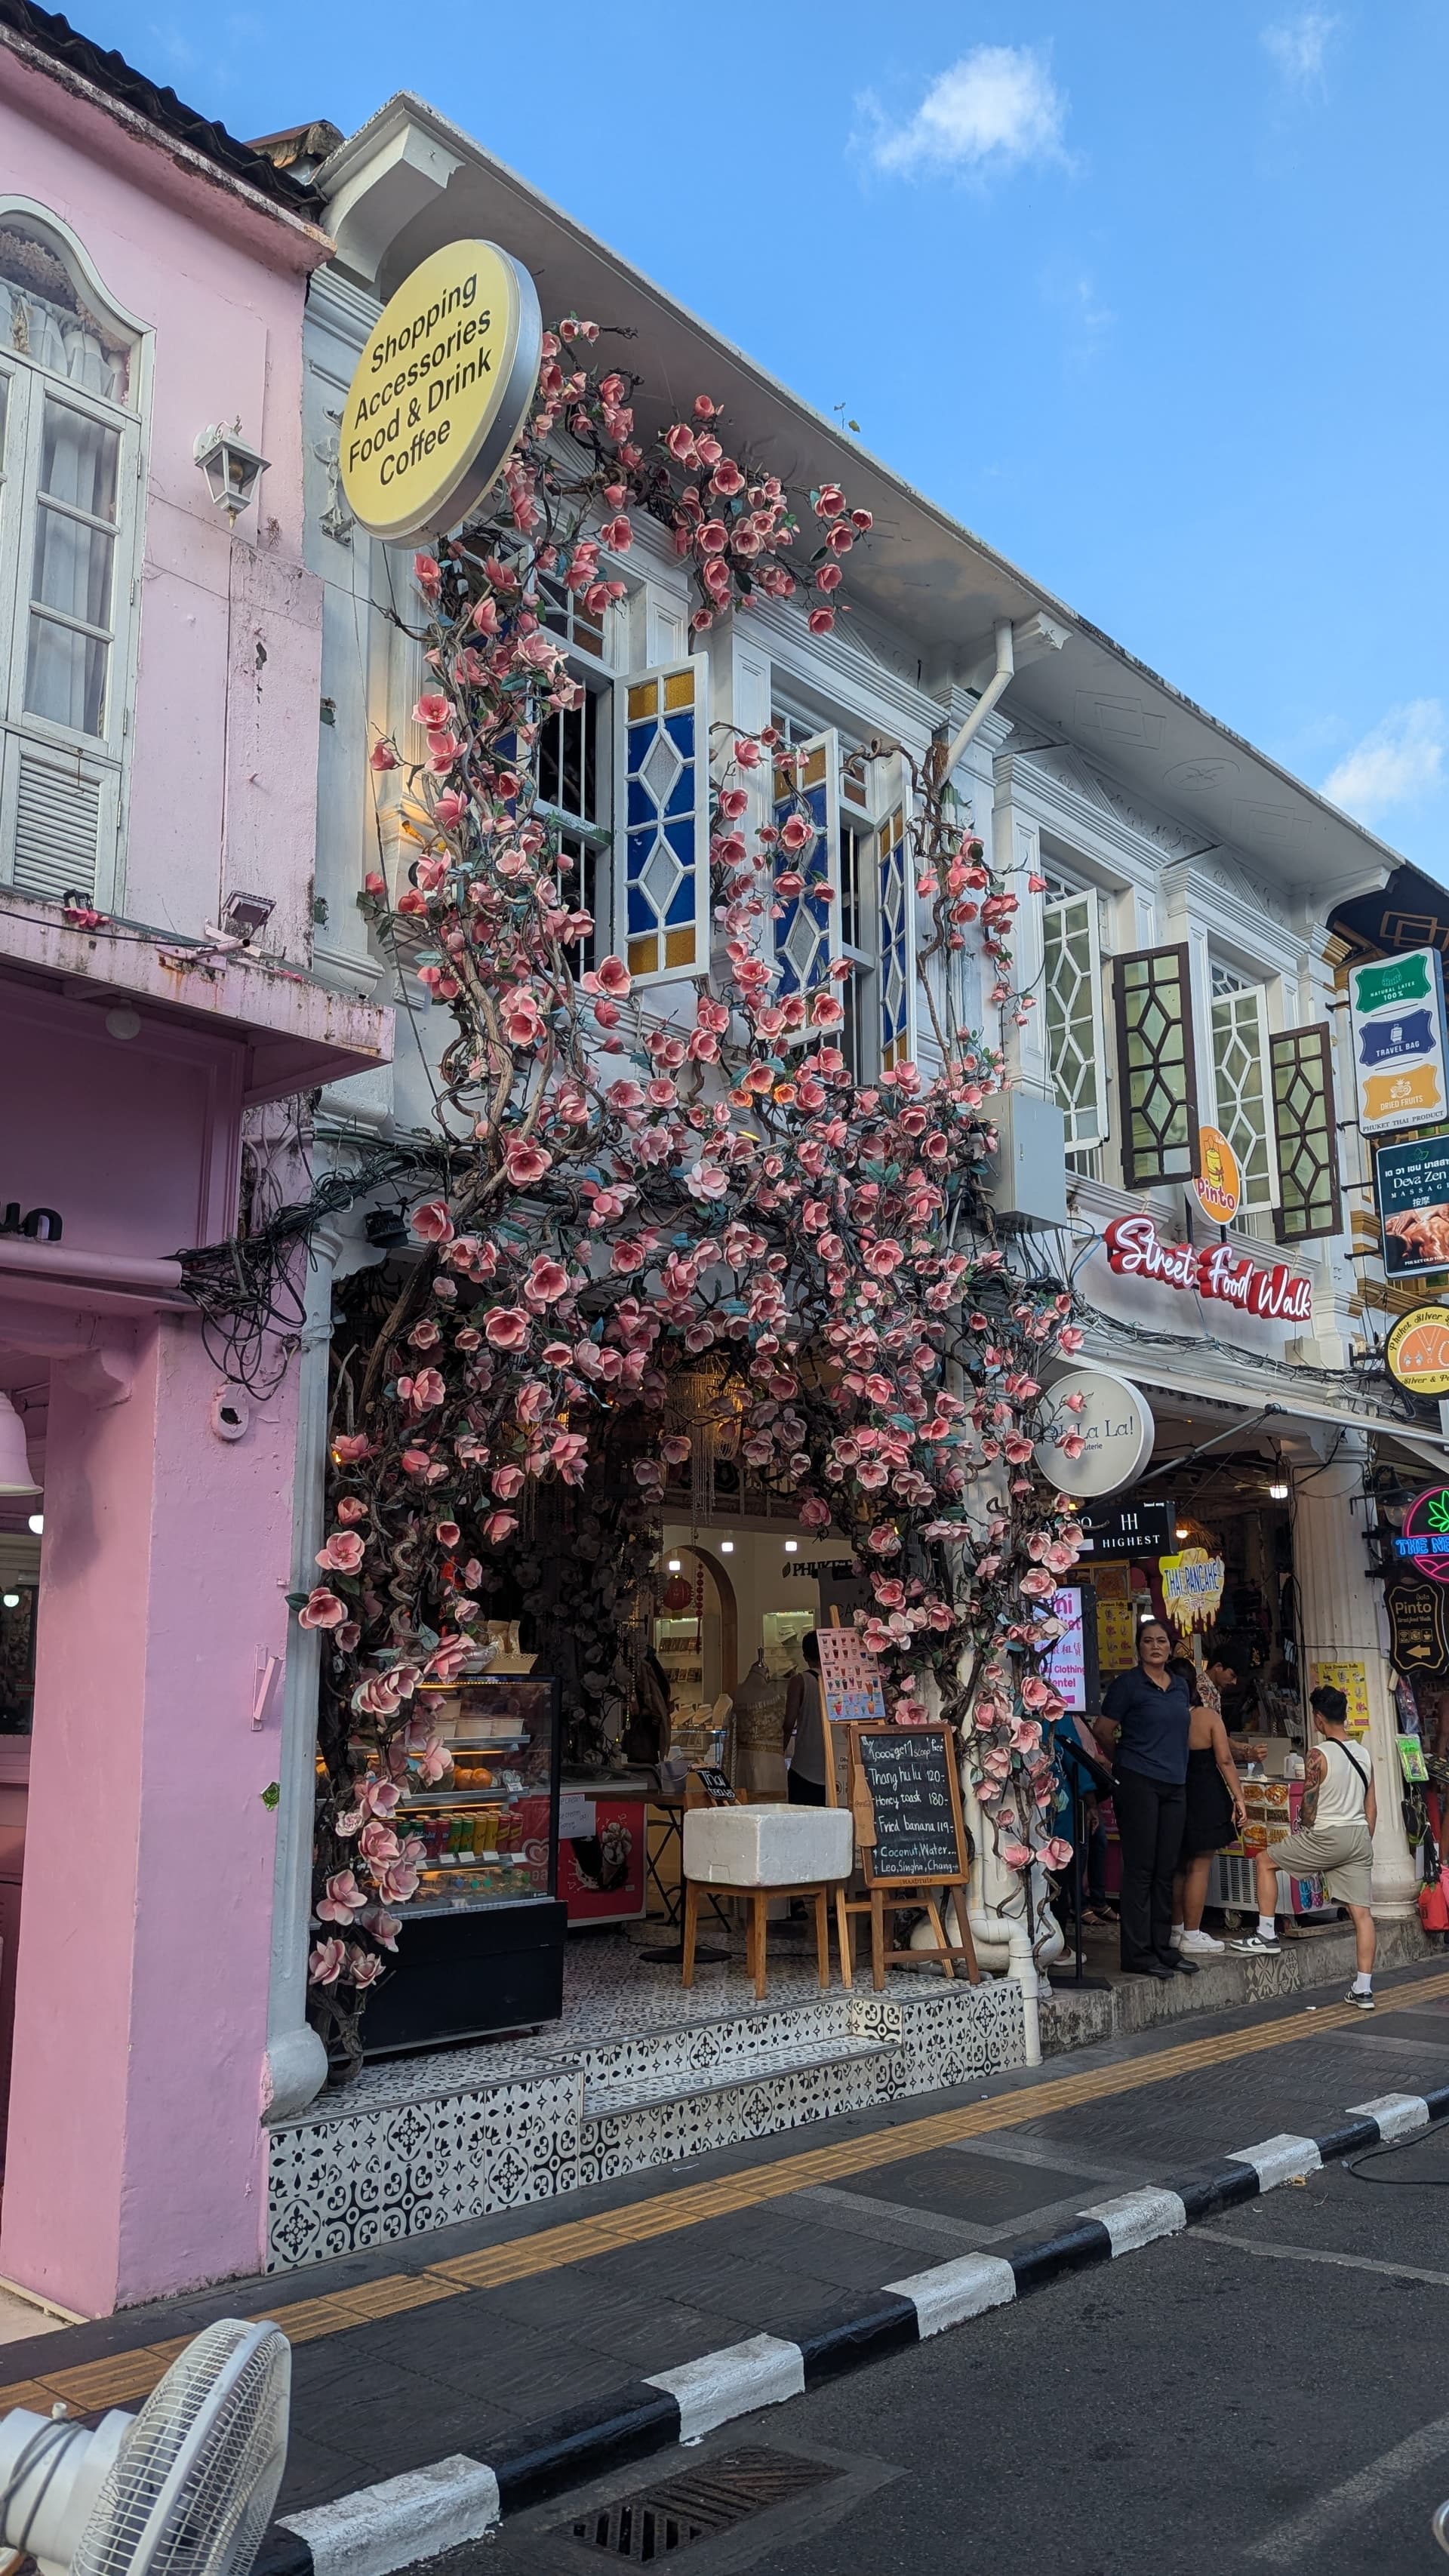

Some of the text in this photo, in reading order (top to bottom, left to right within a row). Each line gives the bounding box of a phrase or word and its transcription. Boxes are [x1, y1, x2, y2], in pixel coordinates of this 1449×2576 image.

[371, 272, 478, 374] Shopping
[354, 309, 491, 429] Accessories
[349, 349, 493, 473] Food & Drink
[380, 419, 451, 486] Coffee
[1370, 986, 1395, 997] NATURAL
[1376, 1040, 1420, 1057] TRAVEL BAG
[1380, 1095, 1423, 1112] DRIED FRUITS
[1362, 1110, 1444, 1132] PHUKET THAI PRODUCT
[1393, 1171, 1447, 1189] Deva Zen
[1116, 1217, 1311, 1317] Street Food Walk
[1389, 1322, 1412, 1351] Phuket
[1414, 1312, 1443, 1324] Silver
[1401, 1377, 1427, 1385] Silver
[1104, 1416, 1134, 1437] La!
[1103, 1534, 1161, 1548] HIGHEST
[1395, 1537, 1429, 1555] THE
[1164, 1562, 1219, 1598] THAI PANCAKE
[1395, 1601, 1432, 1614] Pinto
[1051, 1677, 1075, 1688] entel
[913, 1748, 931, 1760] scoop
[697, 1770, 726, 1787] Thai
[878, 1814, 900, 1833] Fried
[903, 1814, 935, 1832] banana
